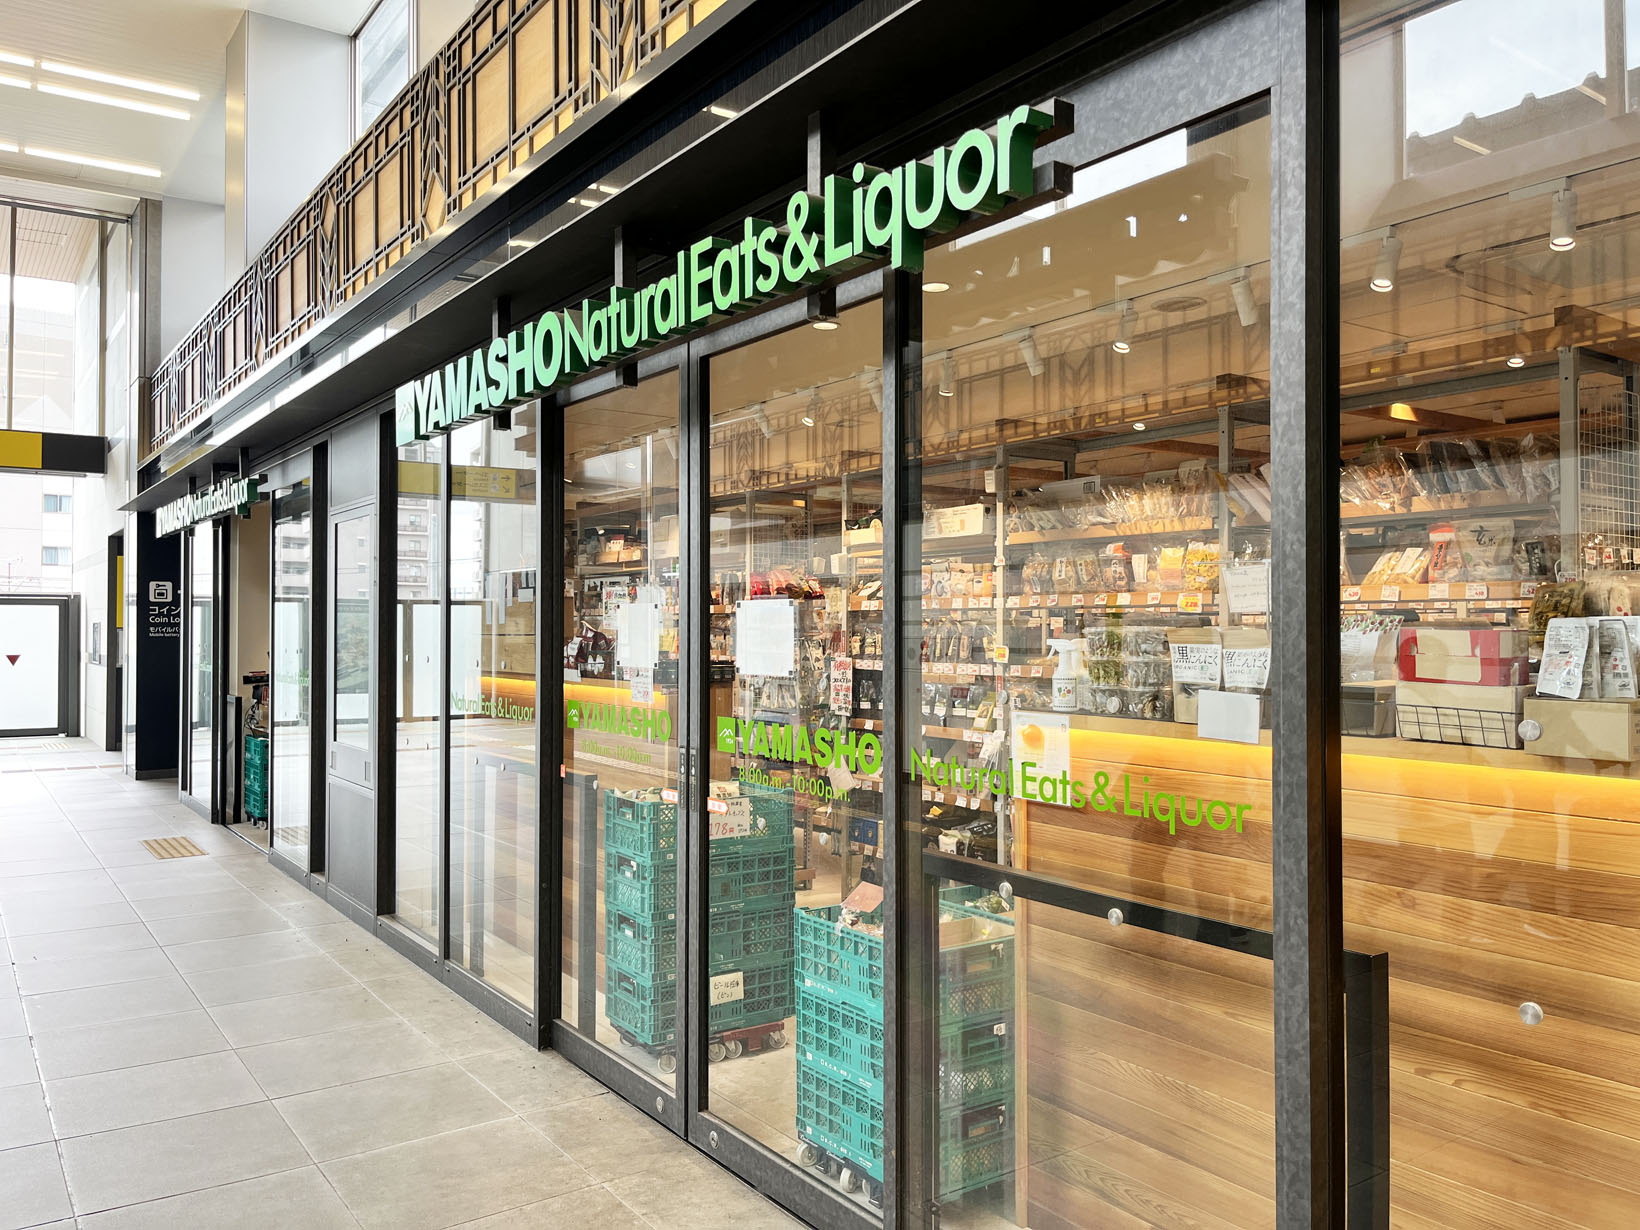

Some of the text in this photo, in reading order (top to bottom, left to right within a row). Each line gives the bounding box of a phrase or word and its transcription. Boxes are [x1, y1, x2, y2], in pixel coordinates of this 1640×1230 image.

[414, 311, 563, 435] YAMASHO
[160, 494, 191, 534] YAMASHO
[149, 605, 181, 615] コイン
[149, 615, 169, 623] Coin
[580, 701, 672, 743] YAMASHO
[737, 719, 882, 775] YAMASHO
[910, 747, 1014, 797] Natural
[1021, 761, 1087, 809] Eats
[1123, 774, 1253, 836] Liquor
